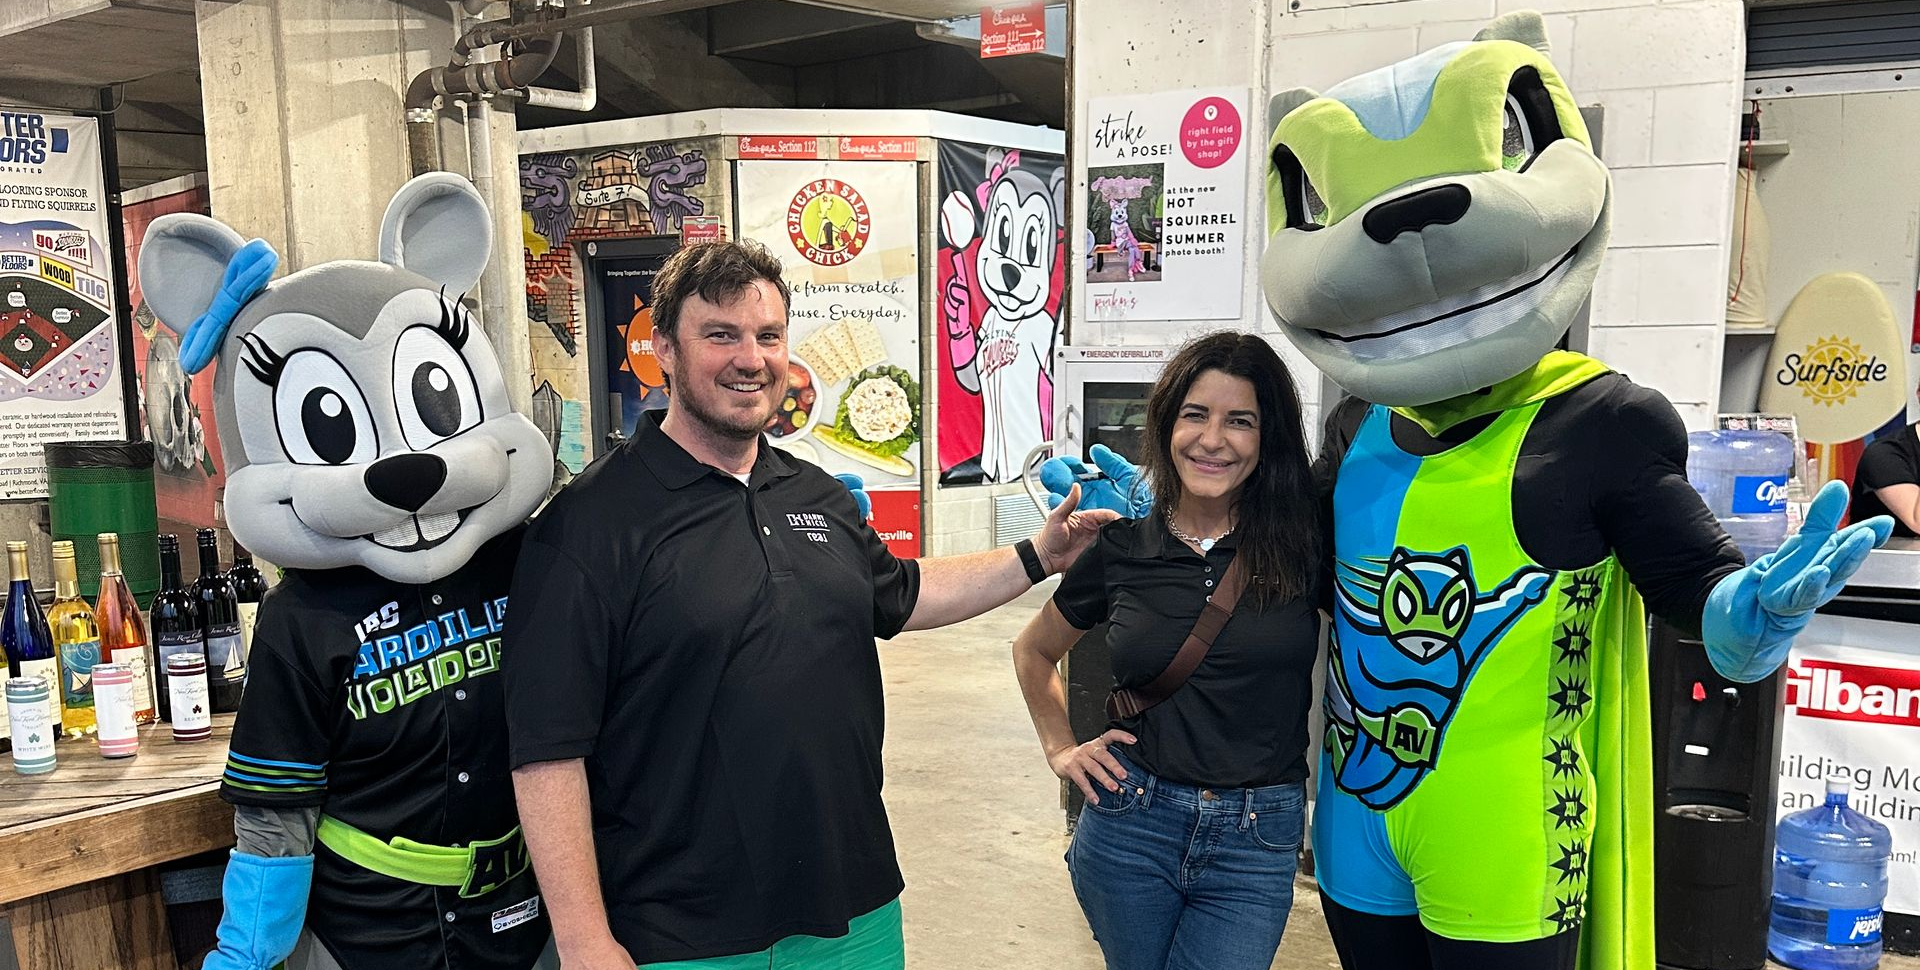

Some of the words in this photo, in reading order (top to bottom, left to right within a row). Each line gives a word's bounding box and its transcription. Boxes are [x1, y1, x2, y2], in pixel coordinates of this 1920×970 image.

[982, 32, 1006, 45] Section
[1007, 31, 1019, 42] 111
[1006, 40, 1030, 53] Section
[1031, 39, 1045, 51] 112
[1096, 111, 1147, 148] strike
[1187, 127, 1209, 138] right
[1211, 125, 1233, 135] field
[778, 140, 803, 153] Section
[804, 141, 816, 153] 112
[878, 140, 902, 153] Section
[903, 141, 915, 153] 111
[1186, 140, 1198, 150] by
[1200, 138, 1215, 147] the
[1217, 136, 1234, 147] gift
[1117, 148, 1125, 158] A
[1131, 144, 1173, 157] POSE!
[1197, 150, 1222, 159] shop!
[44, 186, 88, 198] SPONSOR
[1166, 187, 1177, 195] at
[1179, 186, 1195, 194] the
[12, 200, 46, 210] FLYING
[48, 201, 96, 212] SQUIRRELS
[788, 179, 835, 233] CHICKEN
[839, 185, 870, 233] SALAD
[1167, 198, 1195, 209] HOT
[1166, 214, 1237, 227] SQUIRREL
[36, 234, 53, 250] go
[1166, 233, 1225, 245] SUMMER
[805, 247, 856, 265] CHICK
[1165, 248, 1192, 258] photo
[1194, 246, 1225, 256] booth!
[1, 254, 28, 264] BETTER
[1, 261, 28, 270] FLOORS
[43, 261, 71, 284] WOOD
[76, 276, 105, 300] Tile
[805, 280, 840, 297] from
[844, 280, 904, 294] scratch.
[829, 303, 906, 322] Everyday.
[1120, 350, 1164, 358] DEFIBRILLATOR
[1777, 354, 1887, 385] Surfside
[57, 411, 82, 419] installation
[91, 420, 119, 428] department
[354, 601, 399, 643] LAS
[1392, 722, 1428, 754] AV
[502, 910, 538, 928] EVOSHIELD
